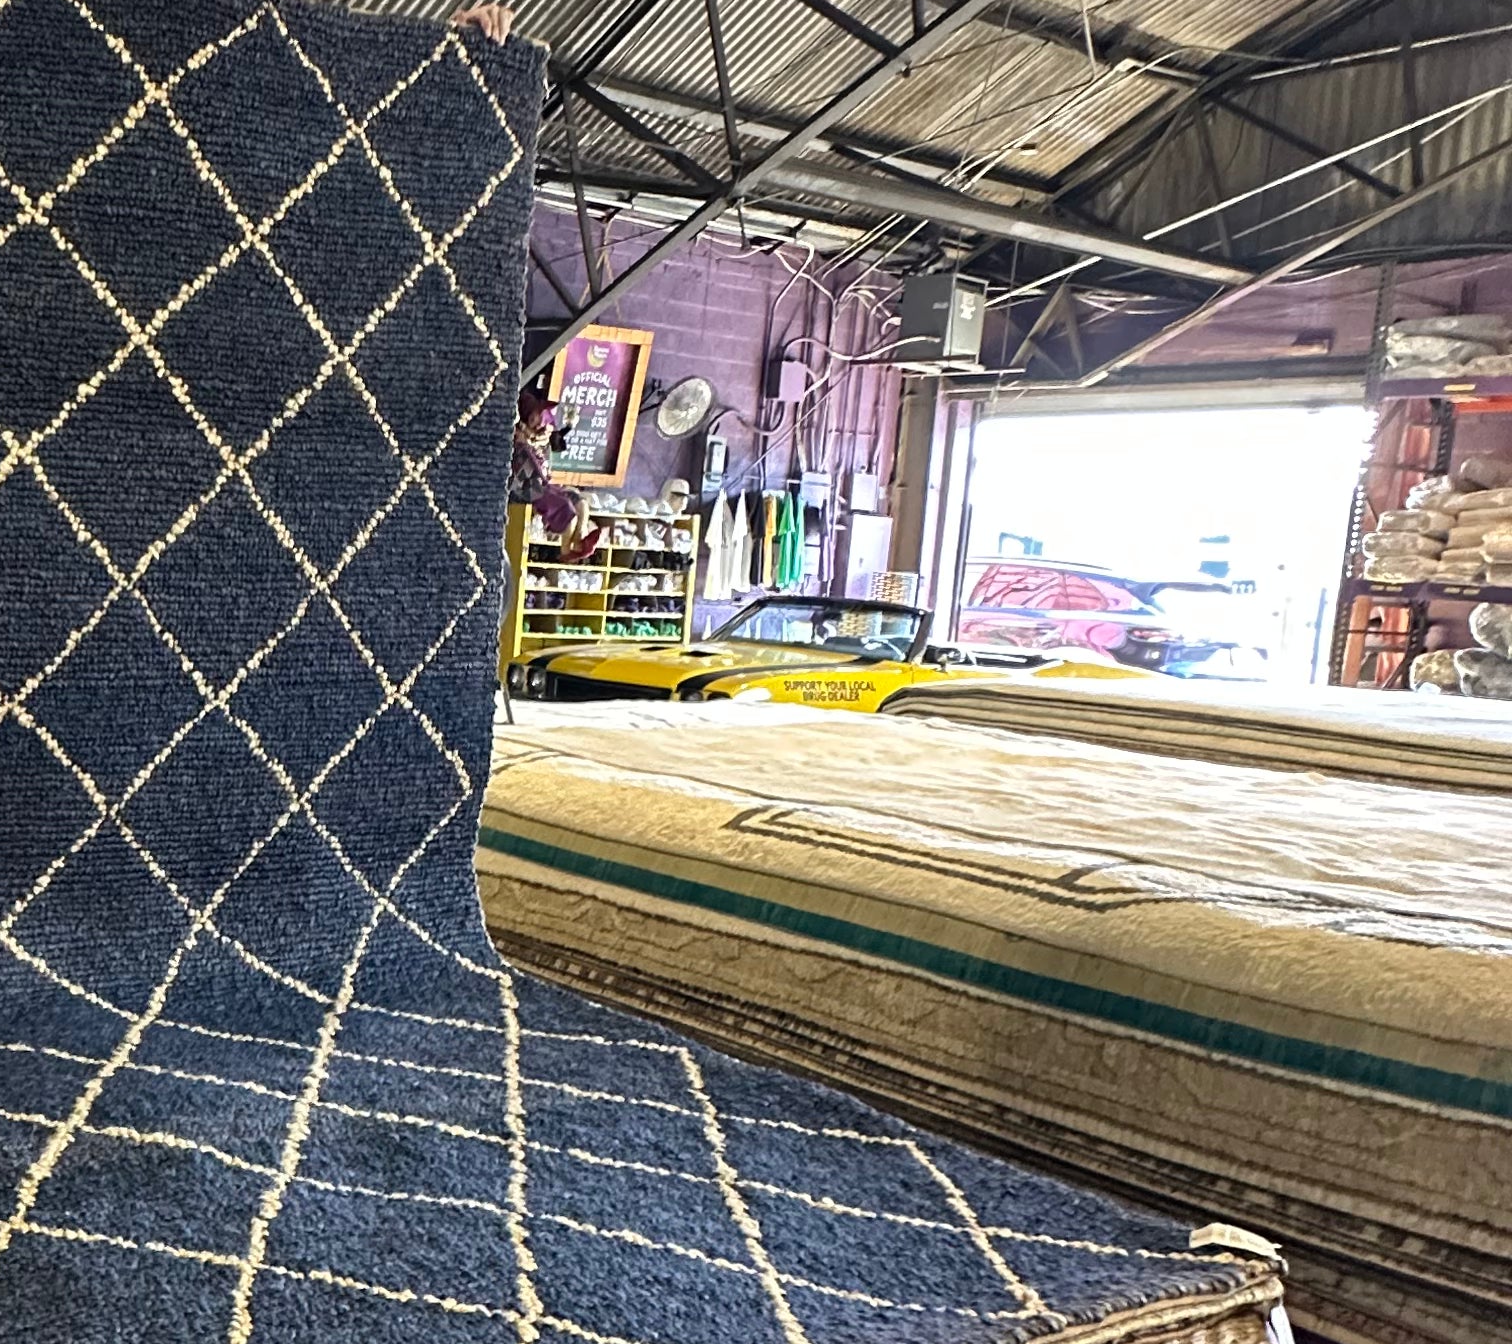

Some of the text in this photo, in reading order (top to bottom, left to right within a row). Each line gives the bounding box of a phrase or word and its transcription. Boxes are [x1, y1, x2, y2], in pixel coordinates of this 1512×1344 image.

[573, 371, 611, 387] OFFICIAL
[561, 385, 618, 408] MERCH
[560, 444, 596, 462] FREE
[783, 680, 876, 691] SUPPORT YOUR LOCAL
[828, 690, 860, 702] DEALER
